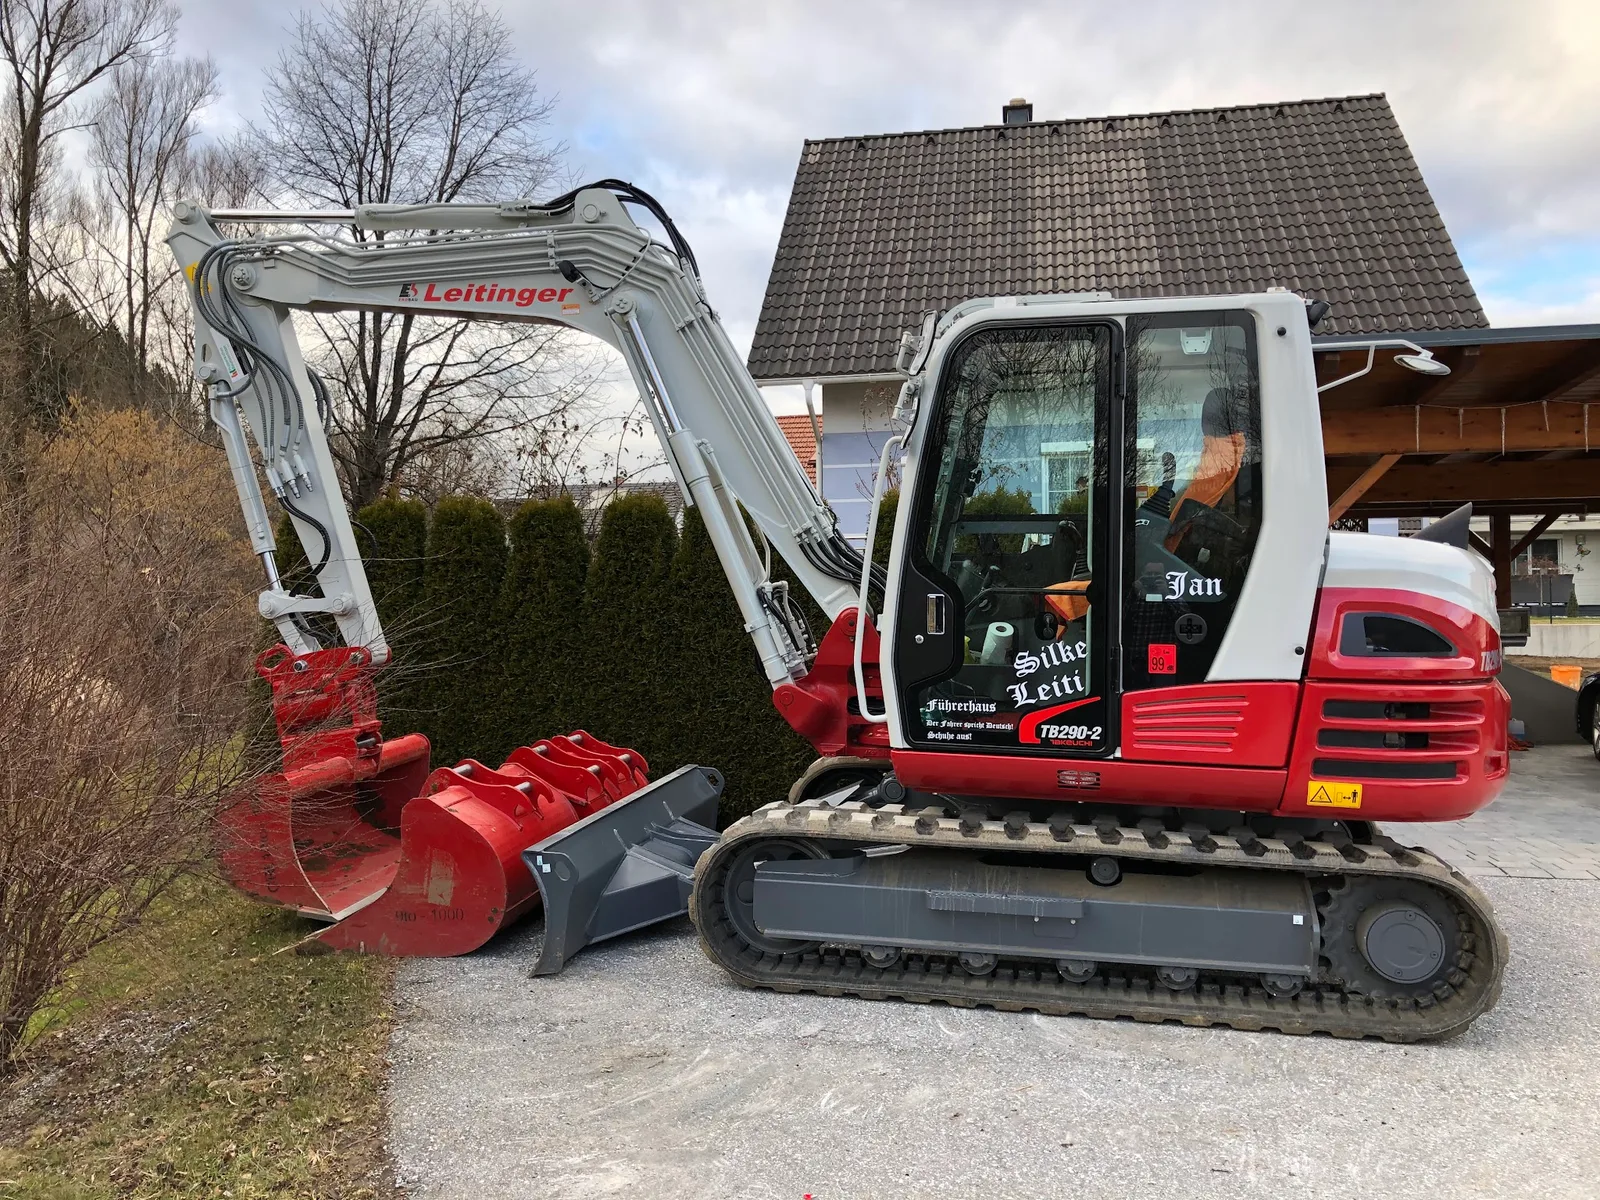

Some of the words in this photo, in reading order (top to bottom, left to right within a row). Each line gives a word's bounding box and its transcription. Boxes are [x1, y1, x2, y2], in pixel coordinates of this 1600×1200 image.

[423, 283, 574, 307] Leitinger
[1164, 571, 1223, 600] Jan
[1013, 640, 1089, 678] Silke
[1151, 657, 1165, 671] 99
[1006, 669, 1085, 709] Leiti
[925, 698, 997, 714] Führerhaus
[939, 720, 963, 730] Fahrer
[1040, 724, 1102, 740] TB290-2
[927, 731, 955, 741] Schuhe
[431, 908, 465, 921] 1000
